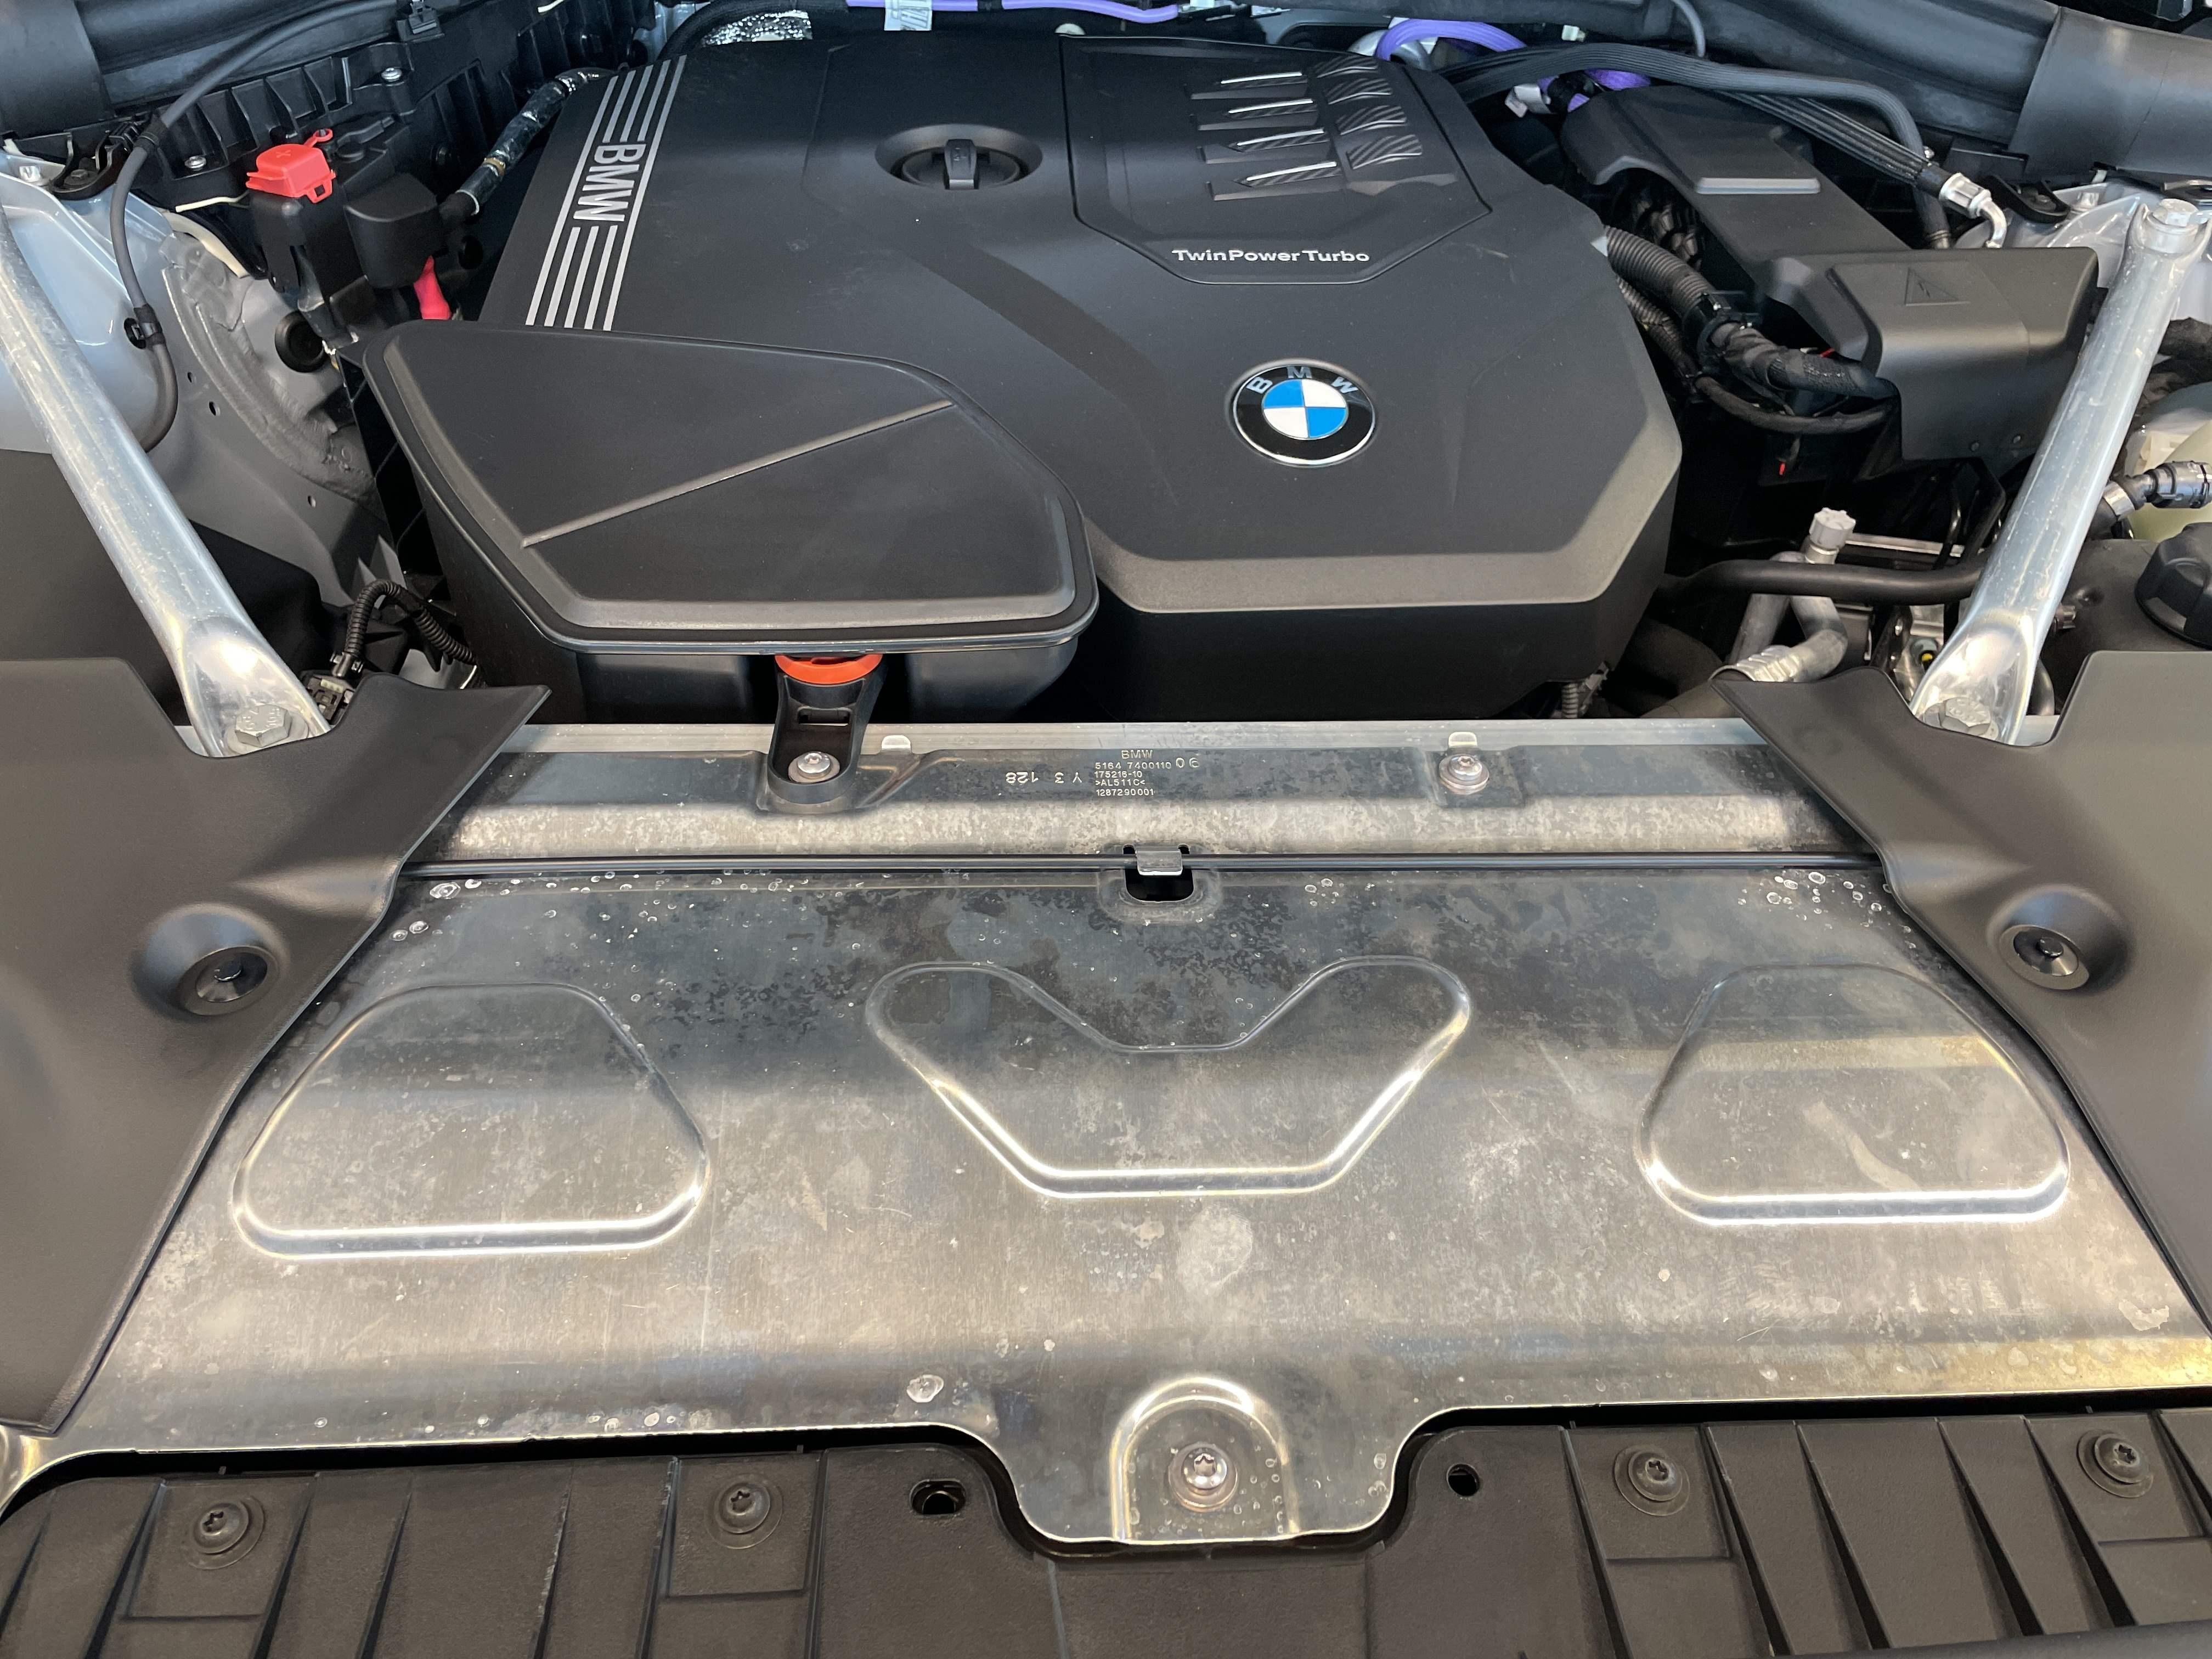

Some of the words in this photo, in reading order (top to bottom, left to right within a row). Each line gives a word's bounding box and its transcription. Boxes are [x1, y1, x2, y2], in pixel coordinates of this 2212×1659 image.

[573, 143, 647, 222] BMW
[1246, 366, 1358, 394] BMW
[1121, 749, 1153, 759] BMW
[1005, 771, 1039, 784] 128
[1096, 788, 1154, 797] 1287290001
